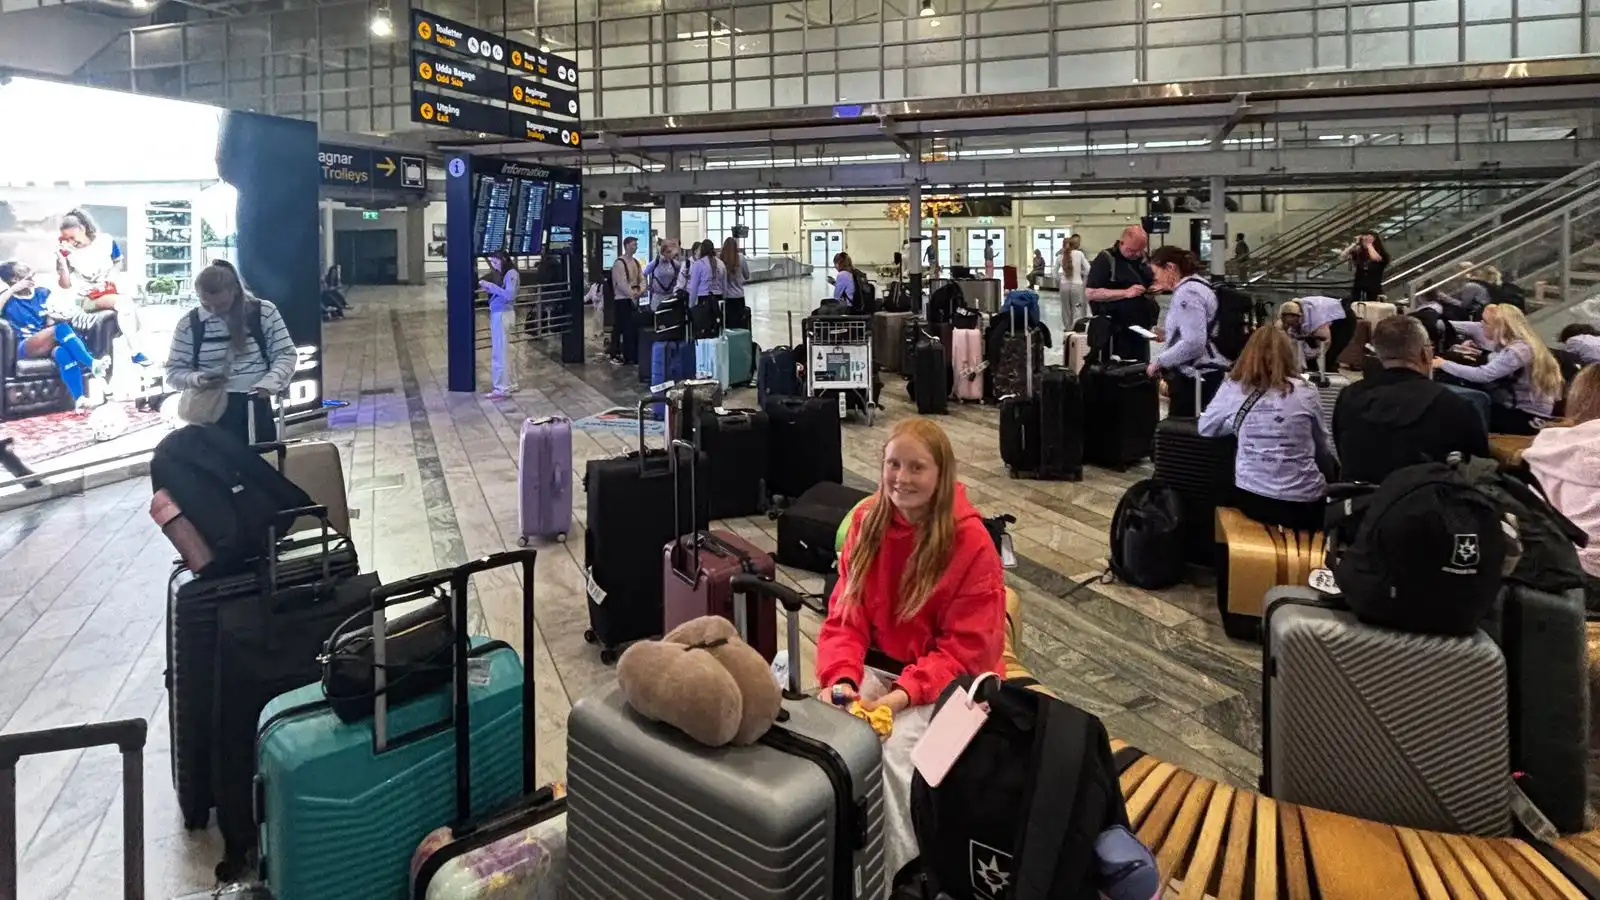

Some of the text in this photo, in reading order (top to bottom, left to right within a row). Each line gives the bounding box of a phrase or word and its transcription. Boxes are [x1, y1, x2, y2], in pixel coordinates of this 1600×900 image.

[435, 62, 476, 82] Udda Bagage
[435, 73, 450, 84] Odd
[436, 102, 460, 117] Utgång
[437, 112, 449, 123] Exit
[322, 166, 368, 184] Trolleys
[501, 162, 550, 178] Information
